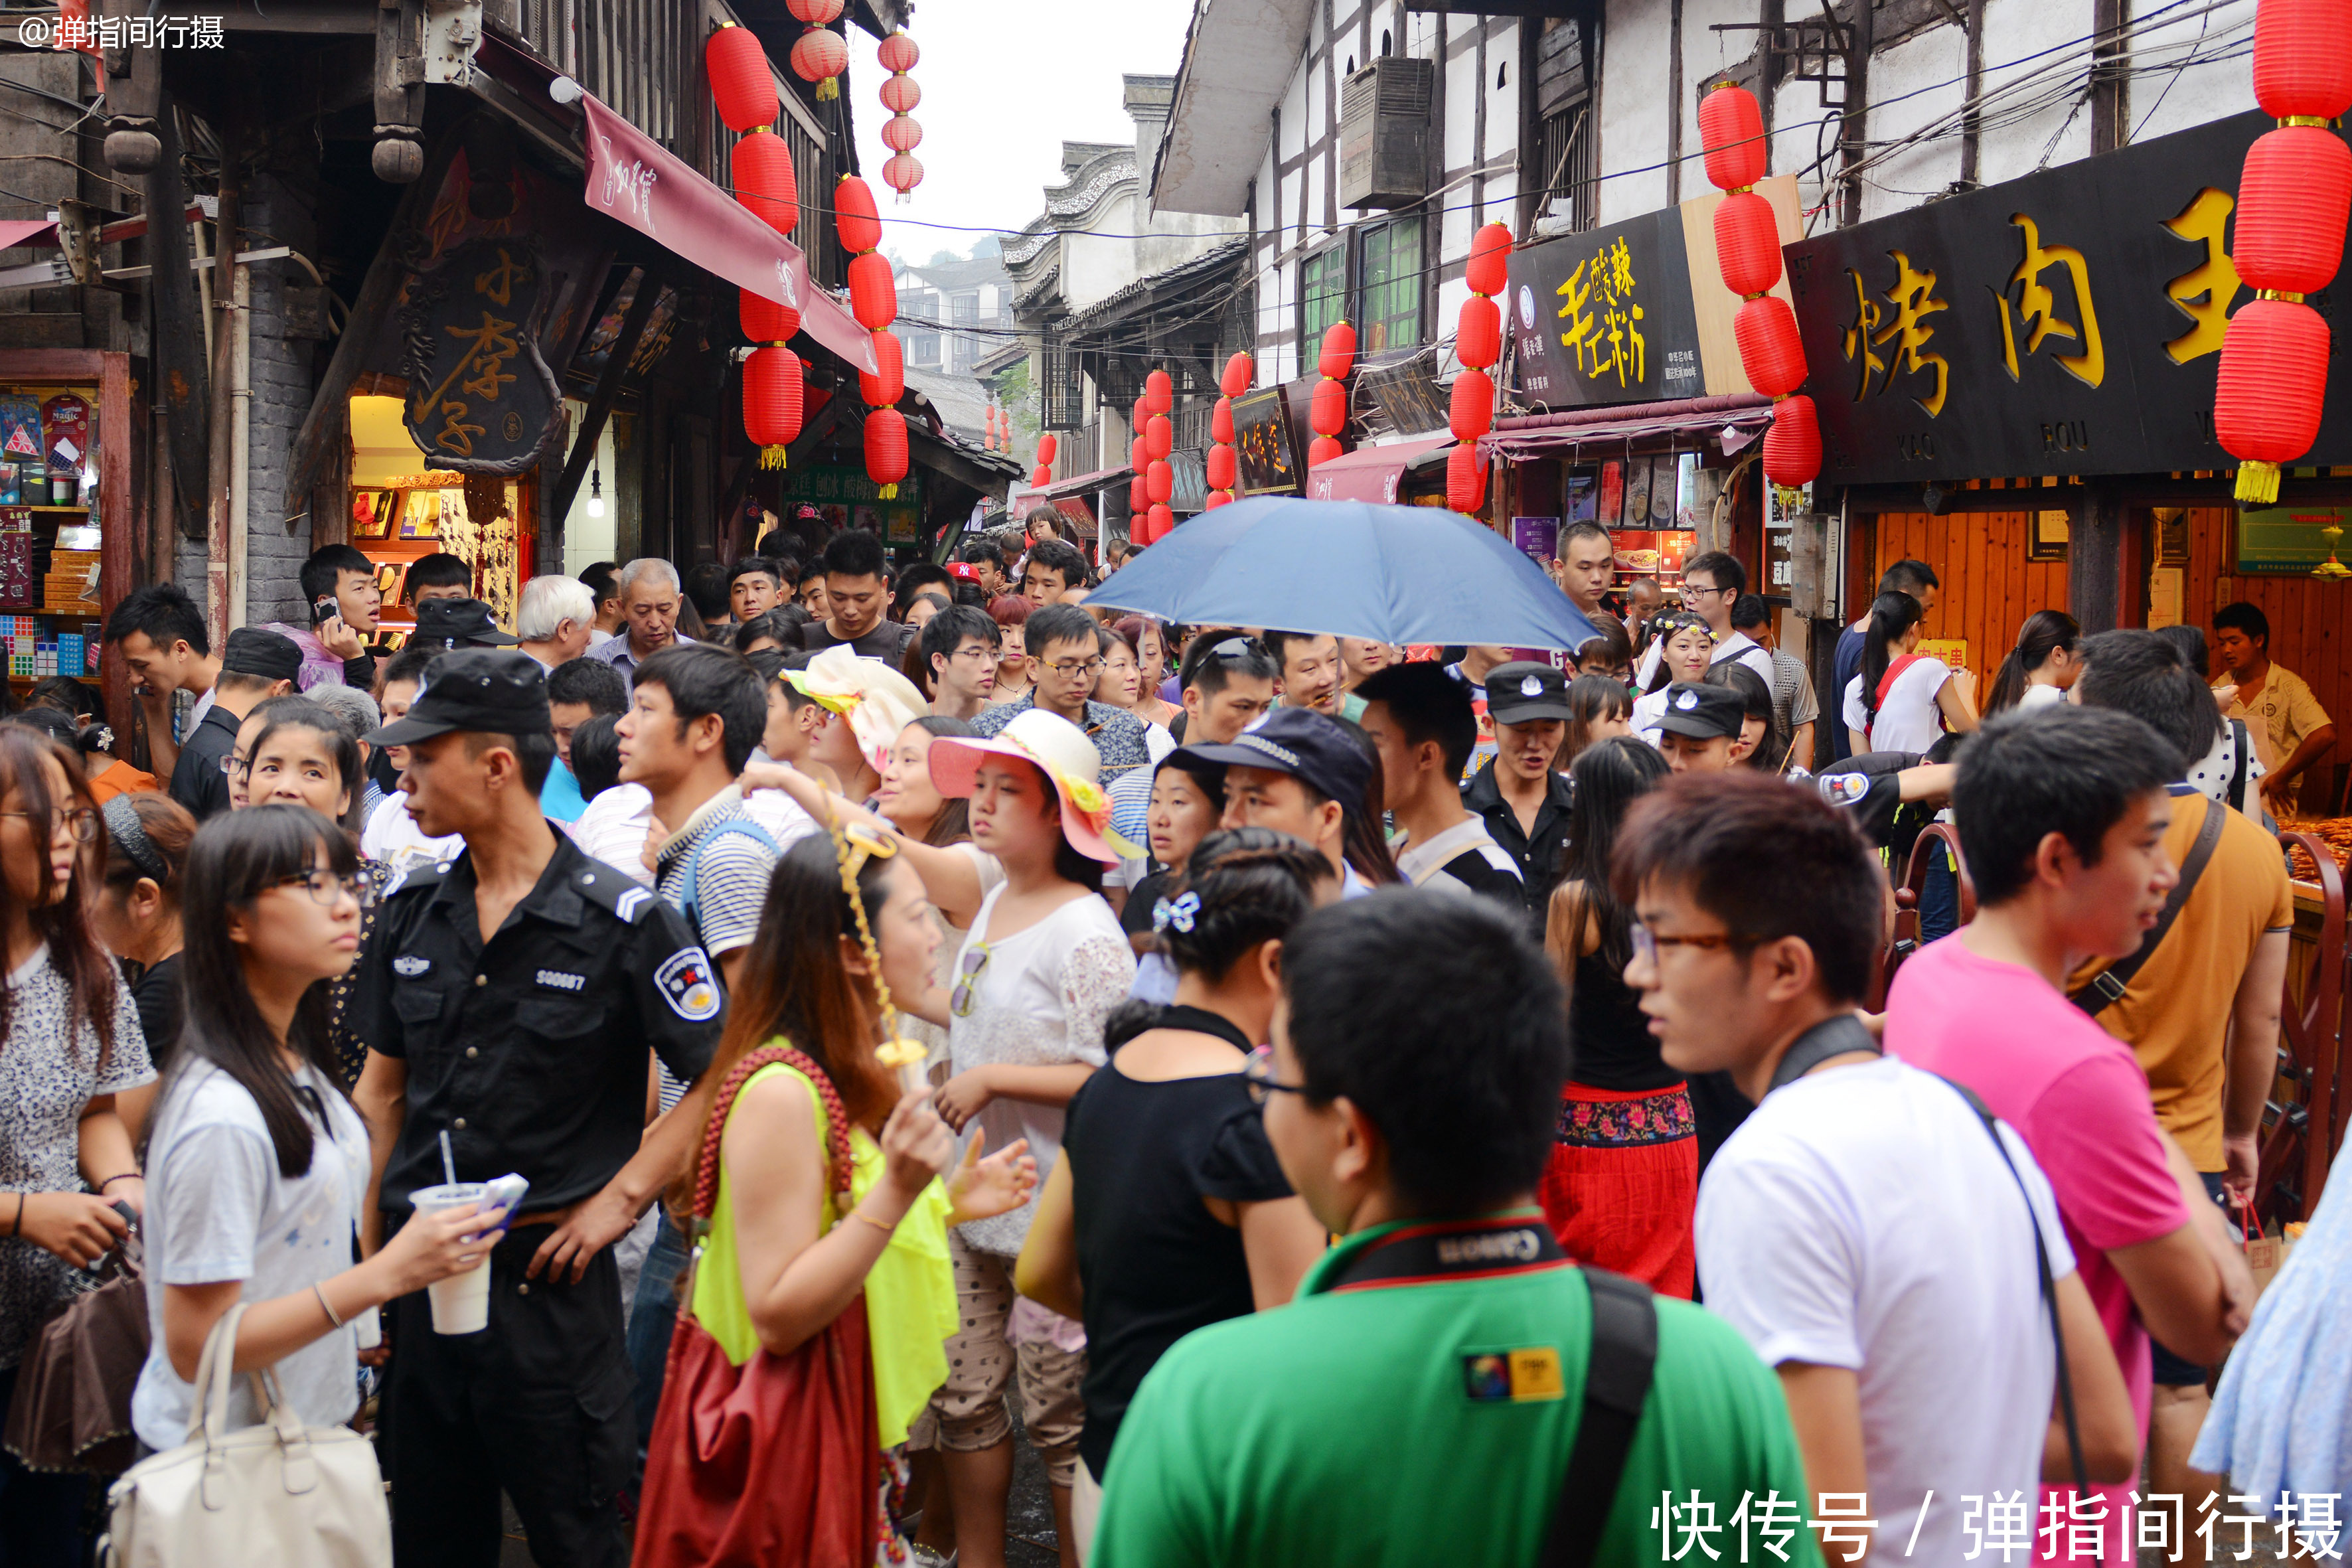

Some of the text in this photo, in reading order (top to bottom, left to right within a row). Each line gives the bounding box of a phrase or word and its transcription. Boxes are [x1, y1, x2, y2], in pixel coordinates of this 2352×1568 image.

[1590, 236, 1636, 307] 酸辣
[1840, 186, 2242, 420] 烤肉王
[413, 247, 533, 457] 小李子
[2040, 420, 2089, 453] ROU
[959, 564, 969, 576] NY
